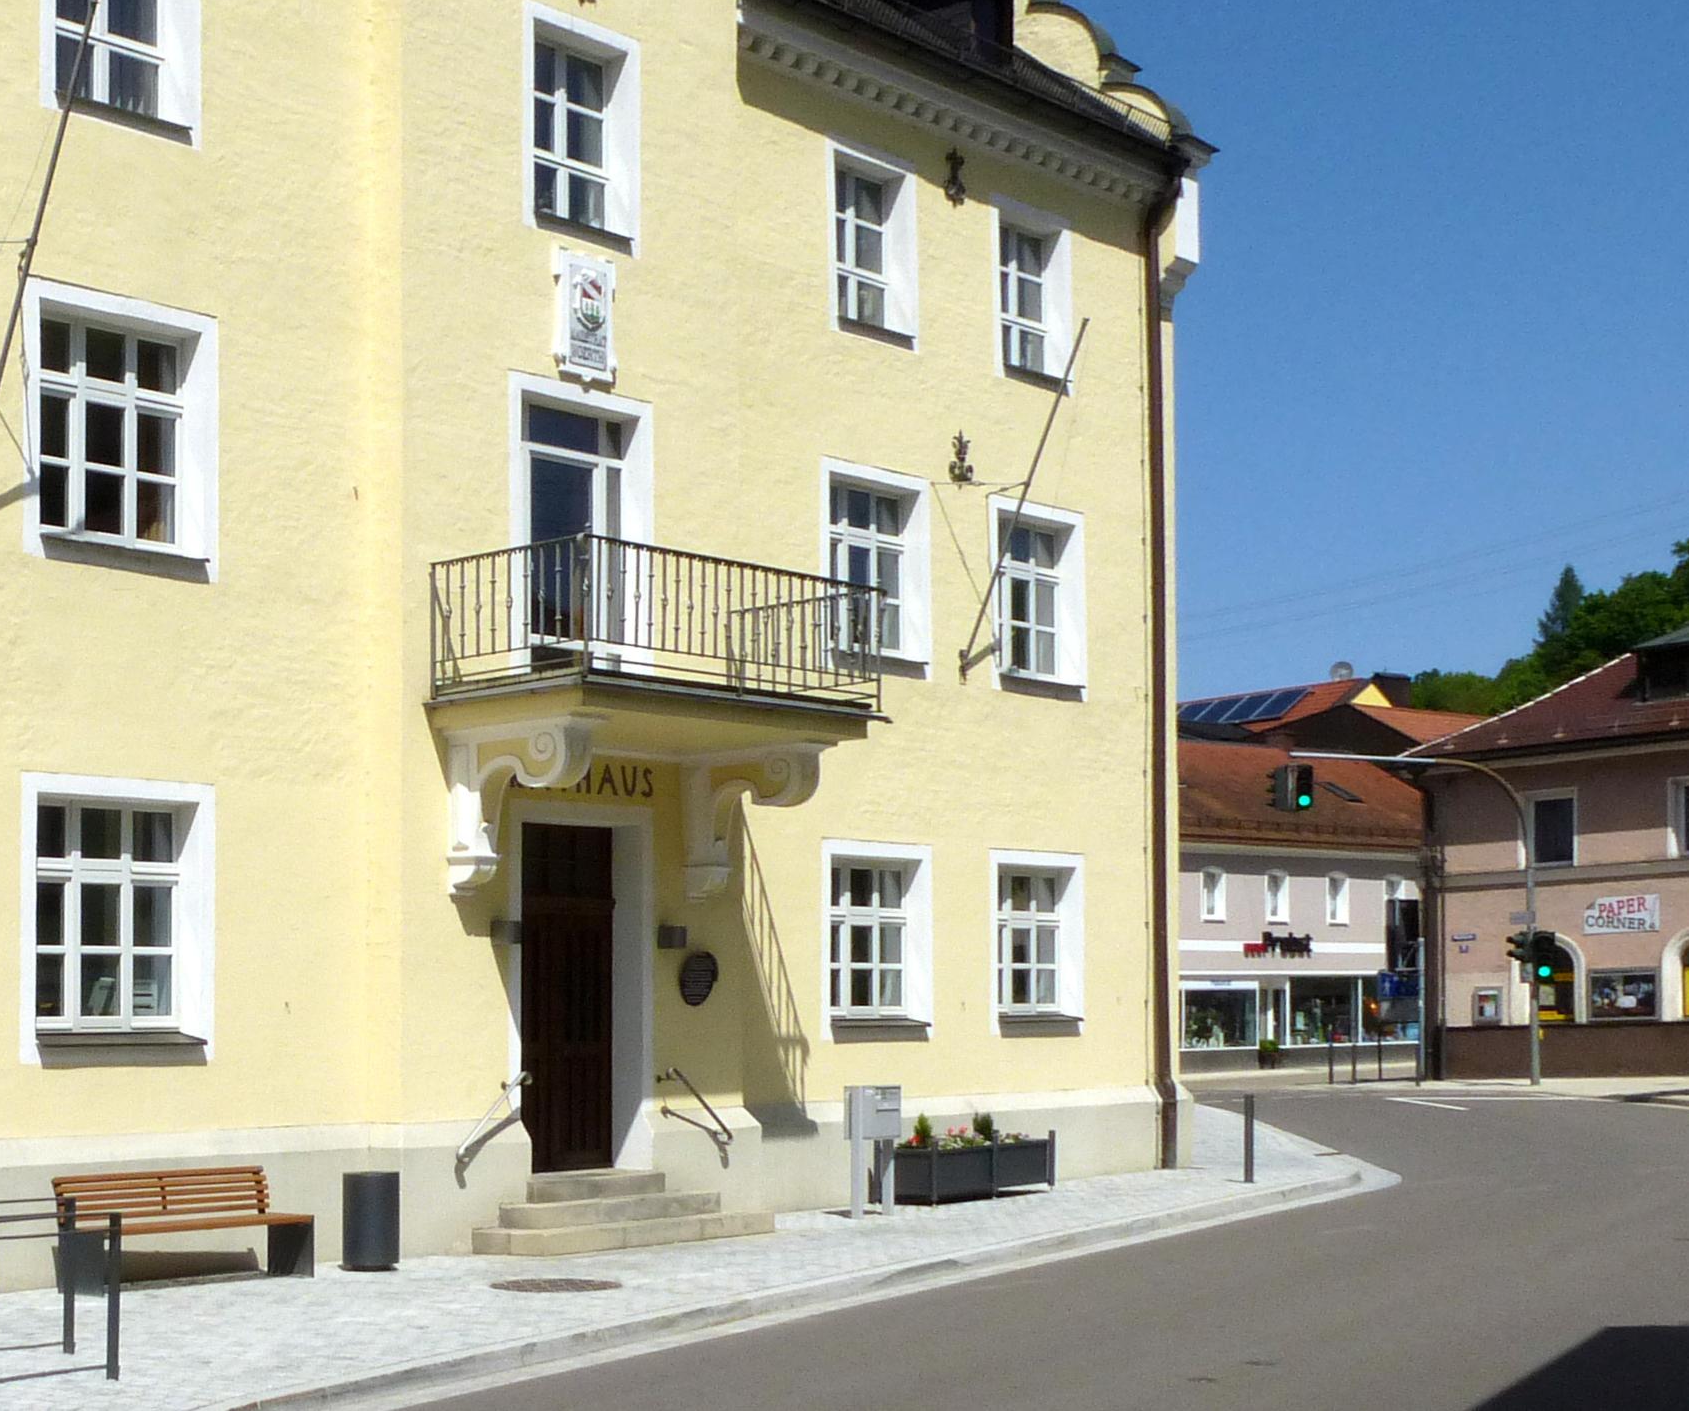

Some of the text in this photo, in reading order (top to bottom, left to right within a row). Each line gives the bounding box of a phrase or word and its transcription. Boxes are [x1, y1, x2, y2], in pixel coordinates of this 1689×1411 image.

[510, 763, 653, 798] HAUS
[1598, 896, 1648, 918] PAPER
[1585, 915, 1646, 930] CORNER
